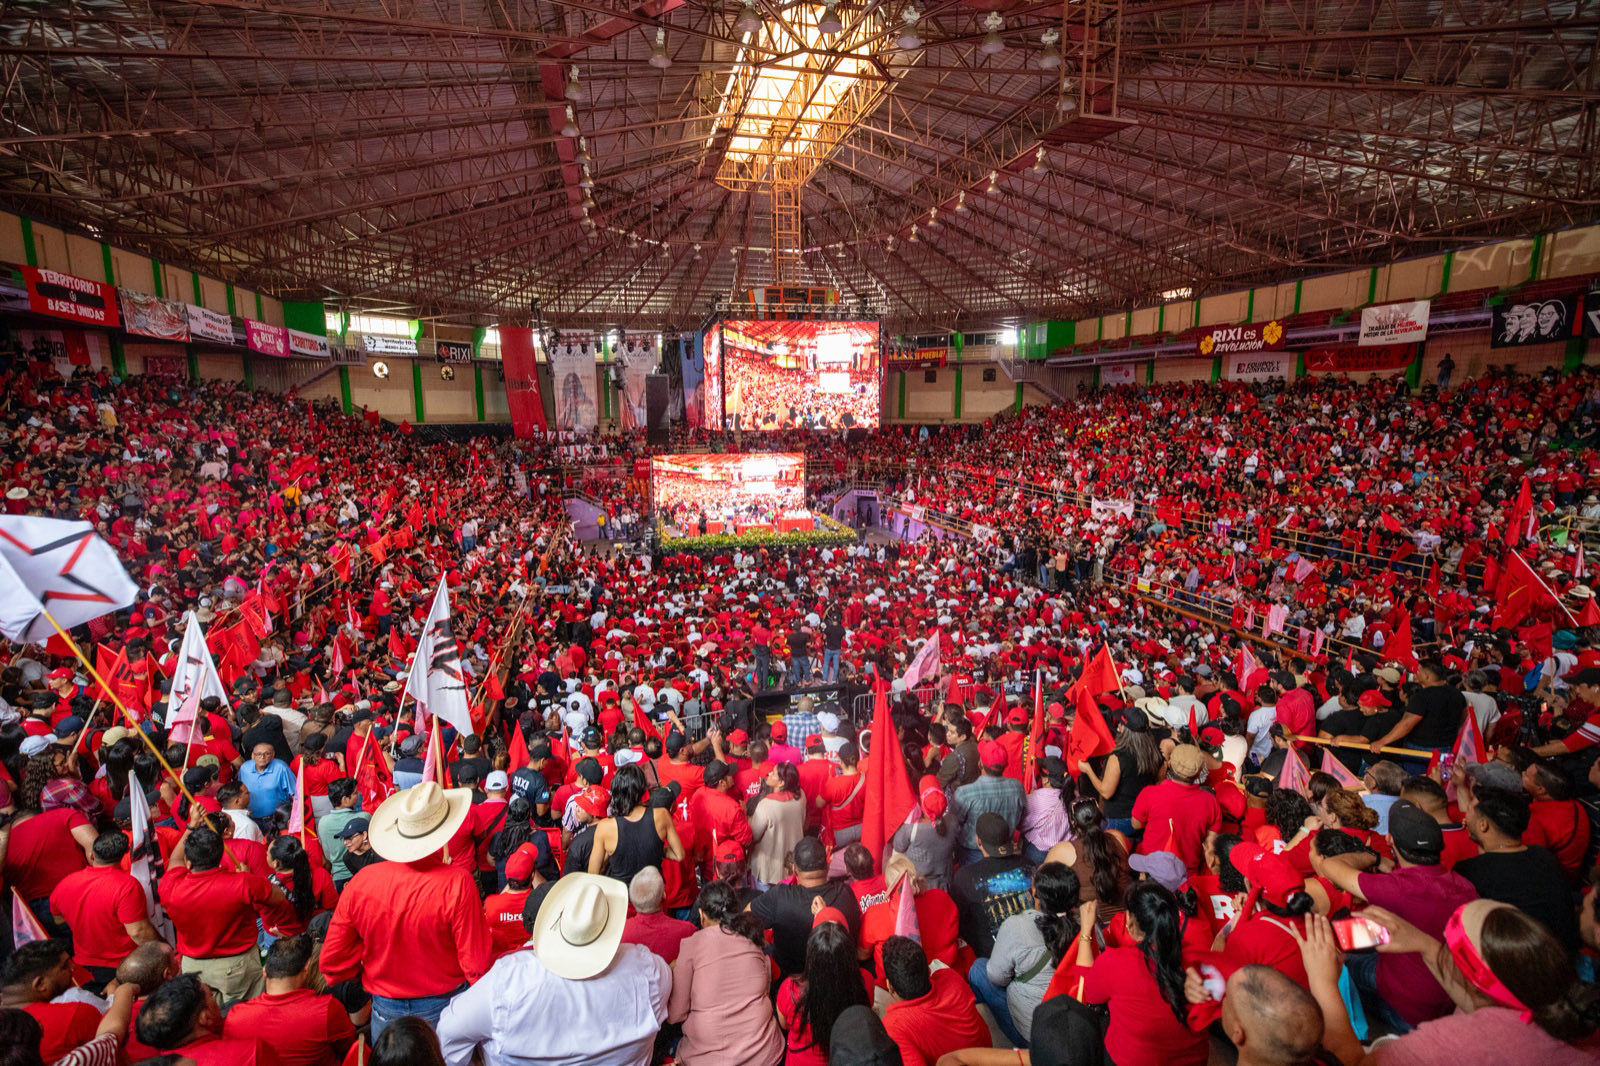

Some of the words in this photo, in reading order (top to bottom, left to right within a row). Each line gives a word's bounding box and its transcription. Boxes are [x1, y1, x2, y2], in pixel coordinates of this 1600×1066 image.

[38, 269, 95, 294] TERRITORIO
[96, 284, 101, 296] 1
[48, 298, 76, 315] BASES
[77, 305, 105, 321] UNIDAS
[261, 332, 275, 344] RIXI
[1213, 327, 1242, 343] RIXI
[1244, 329, 1256, 340] es
[450, 346, 470, 360] RIXI
[1214, 339, 1264, 354] REVOLUCIÓN
[513, 775, 530, 791] RIXI
